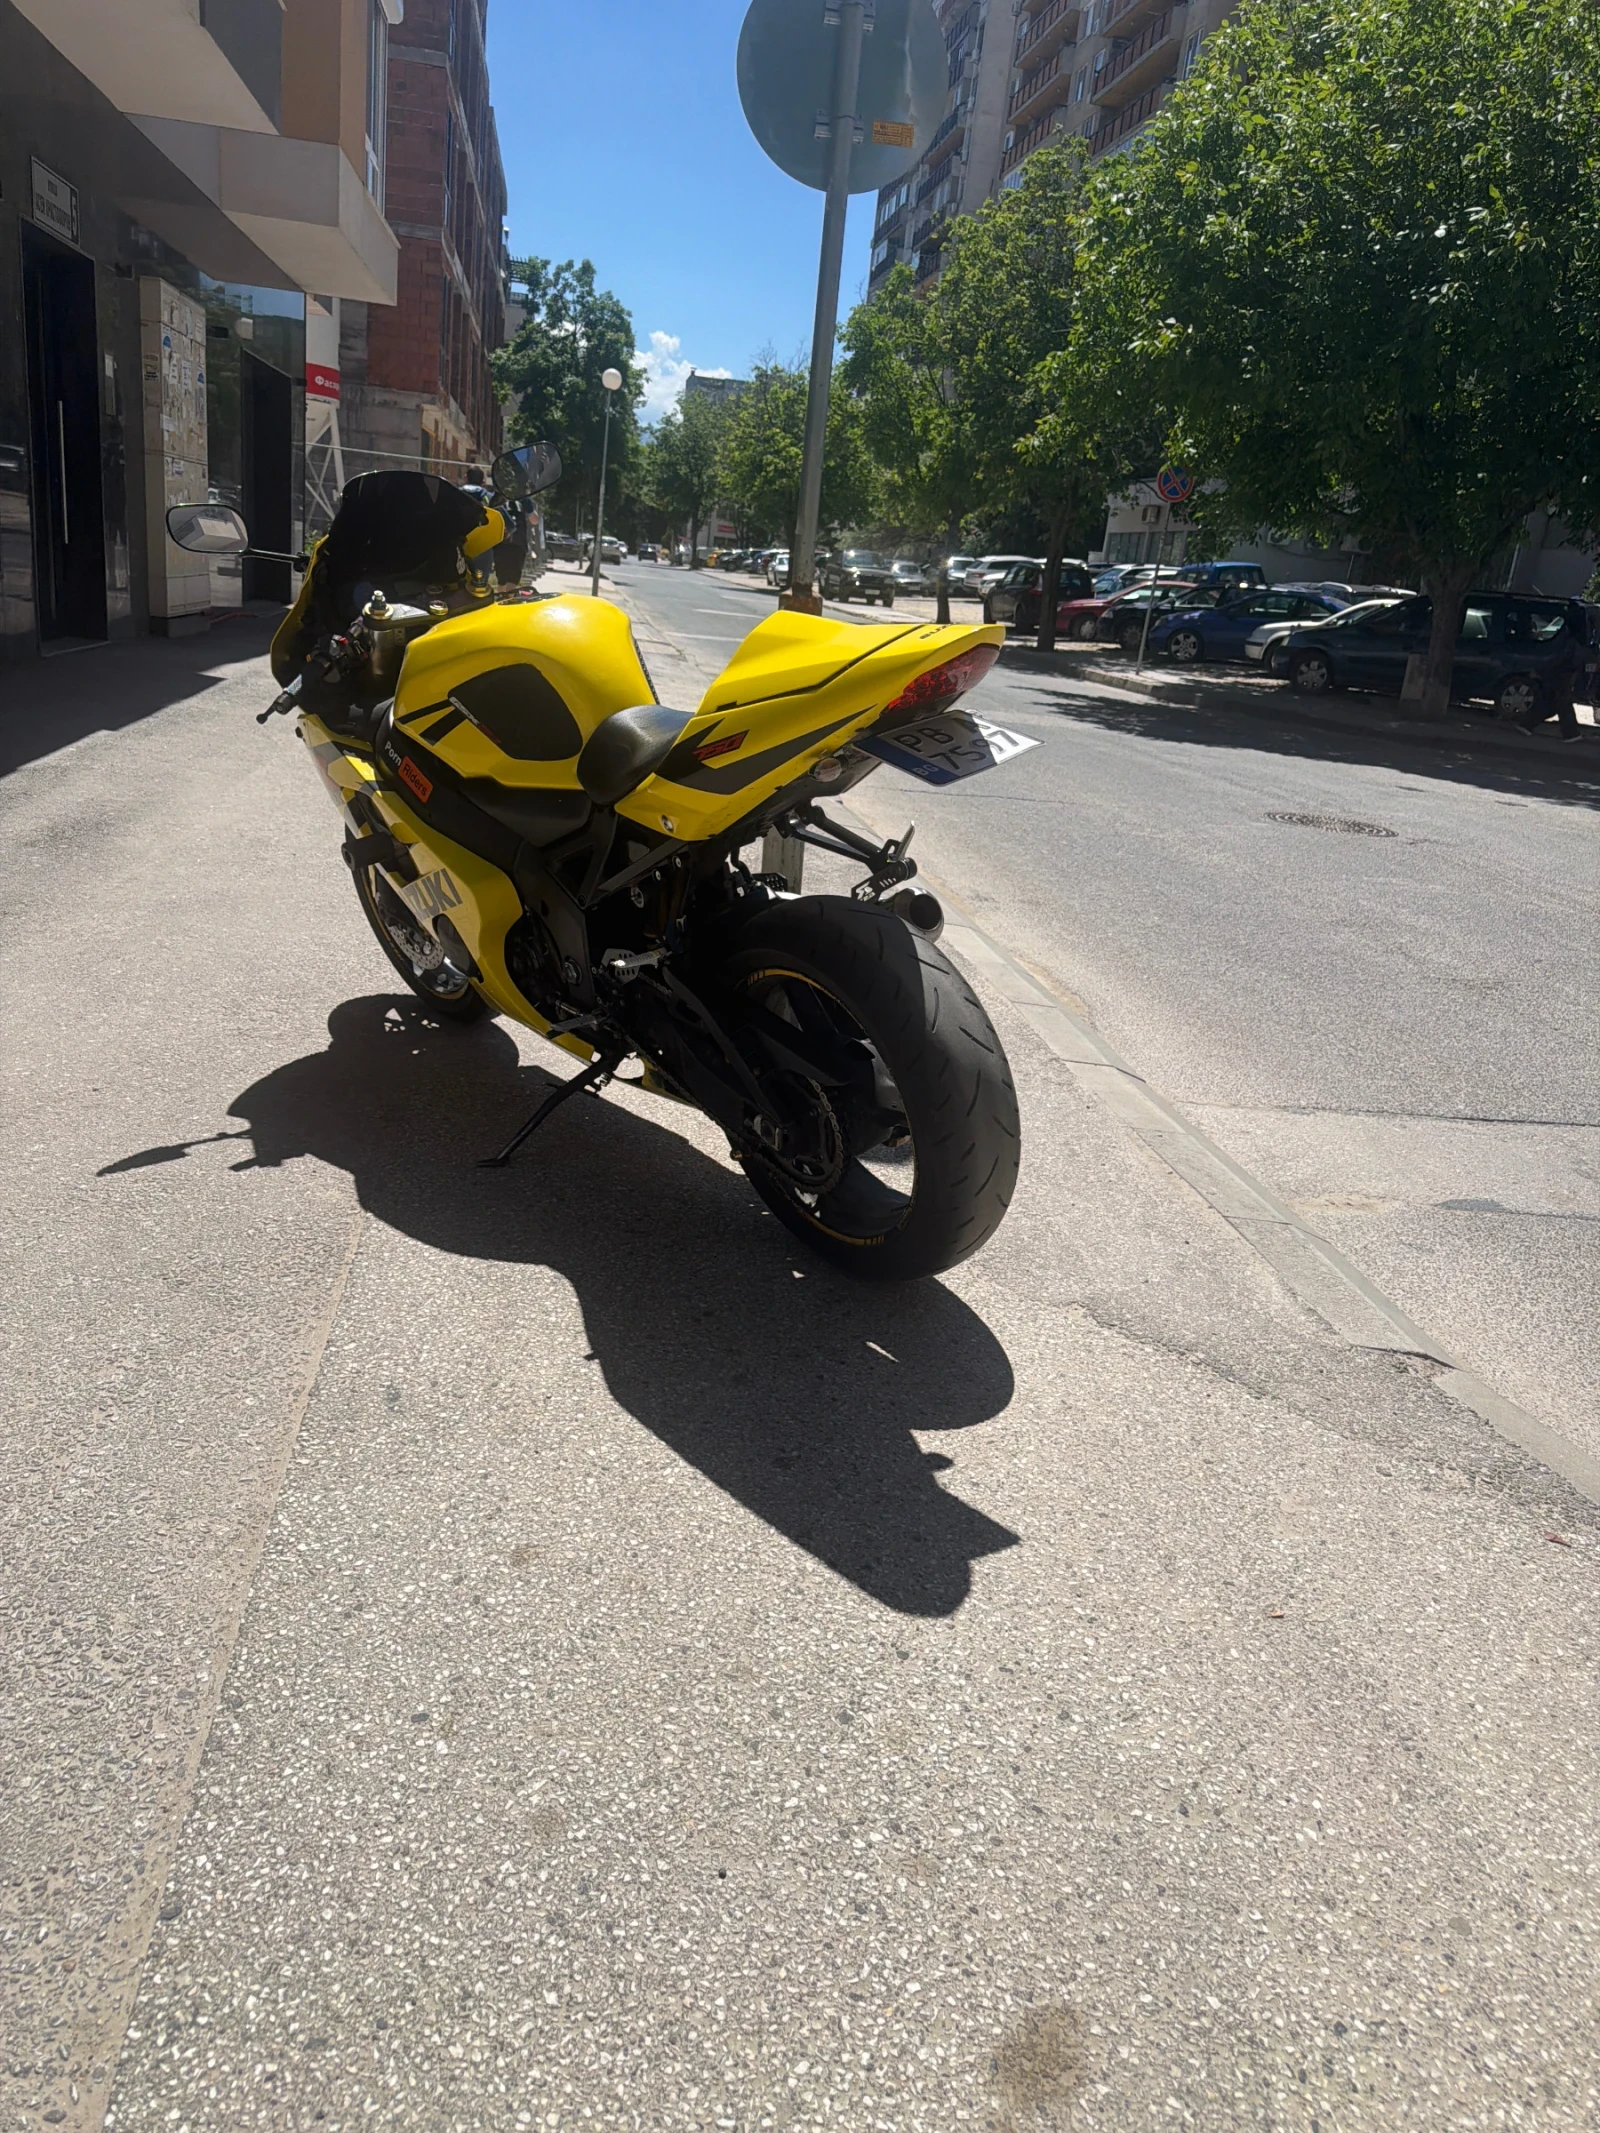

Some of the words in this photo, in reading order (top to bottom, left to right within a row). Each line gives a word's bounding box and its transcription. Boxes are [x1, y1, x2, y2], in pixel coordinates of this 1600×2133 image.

[893, 727, 954, 753] PB
[928, 730, 1019, 770] 7597
[384, 741, 402, 767] Porn
[402, 763, 428, 797] Riders
[913, 764, 939, 776] BG
[401, 867, 463, 920] ZUKI
